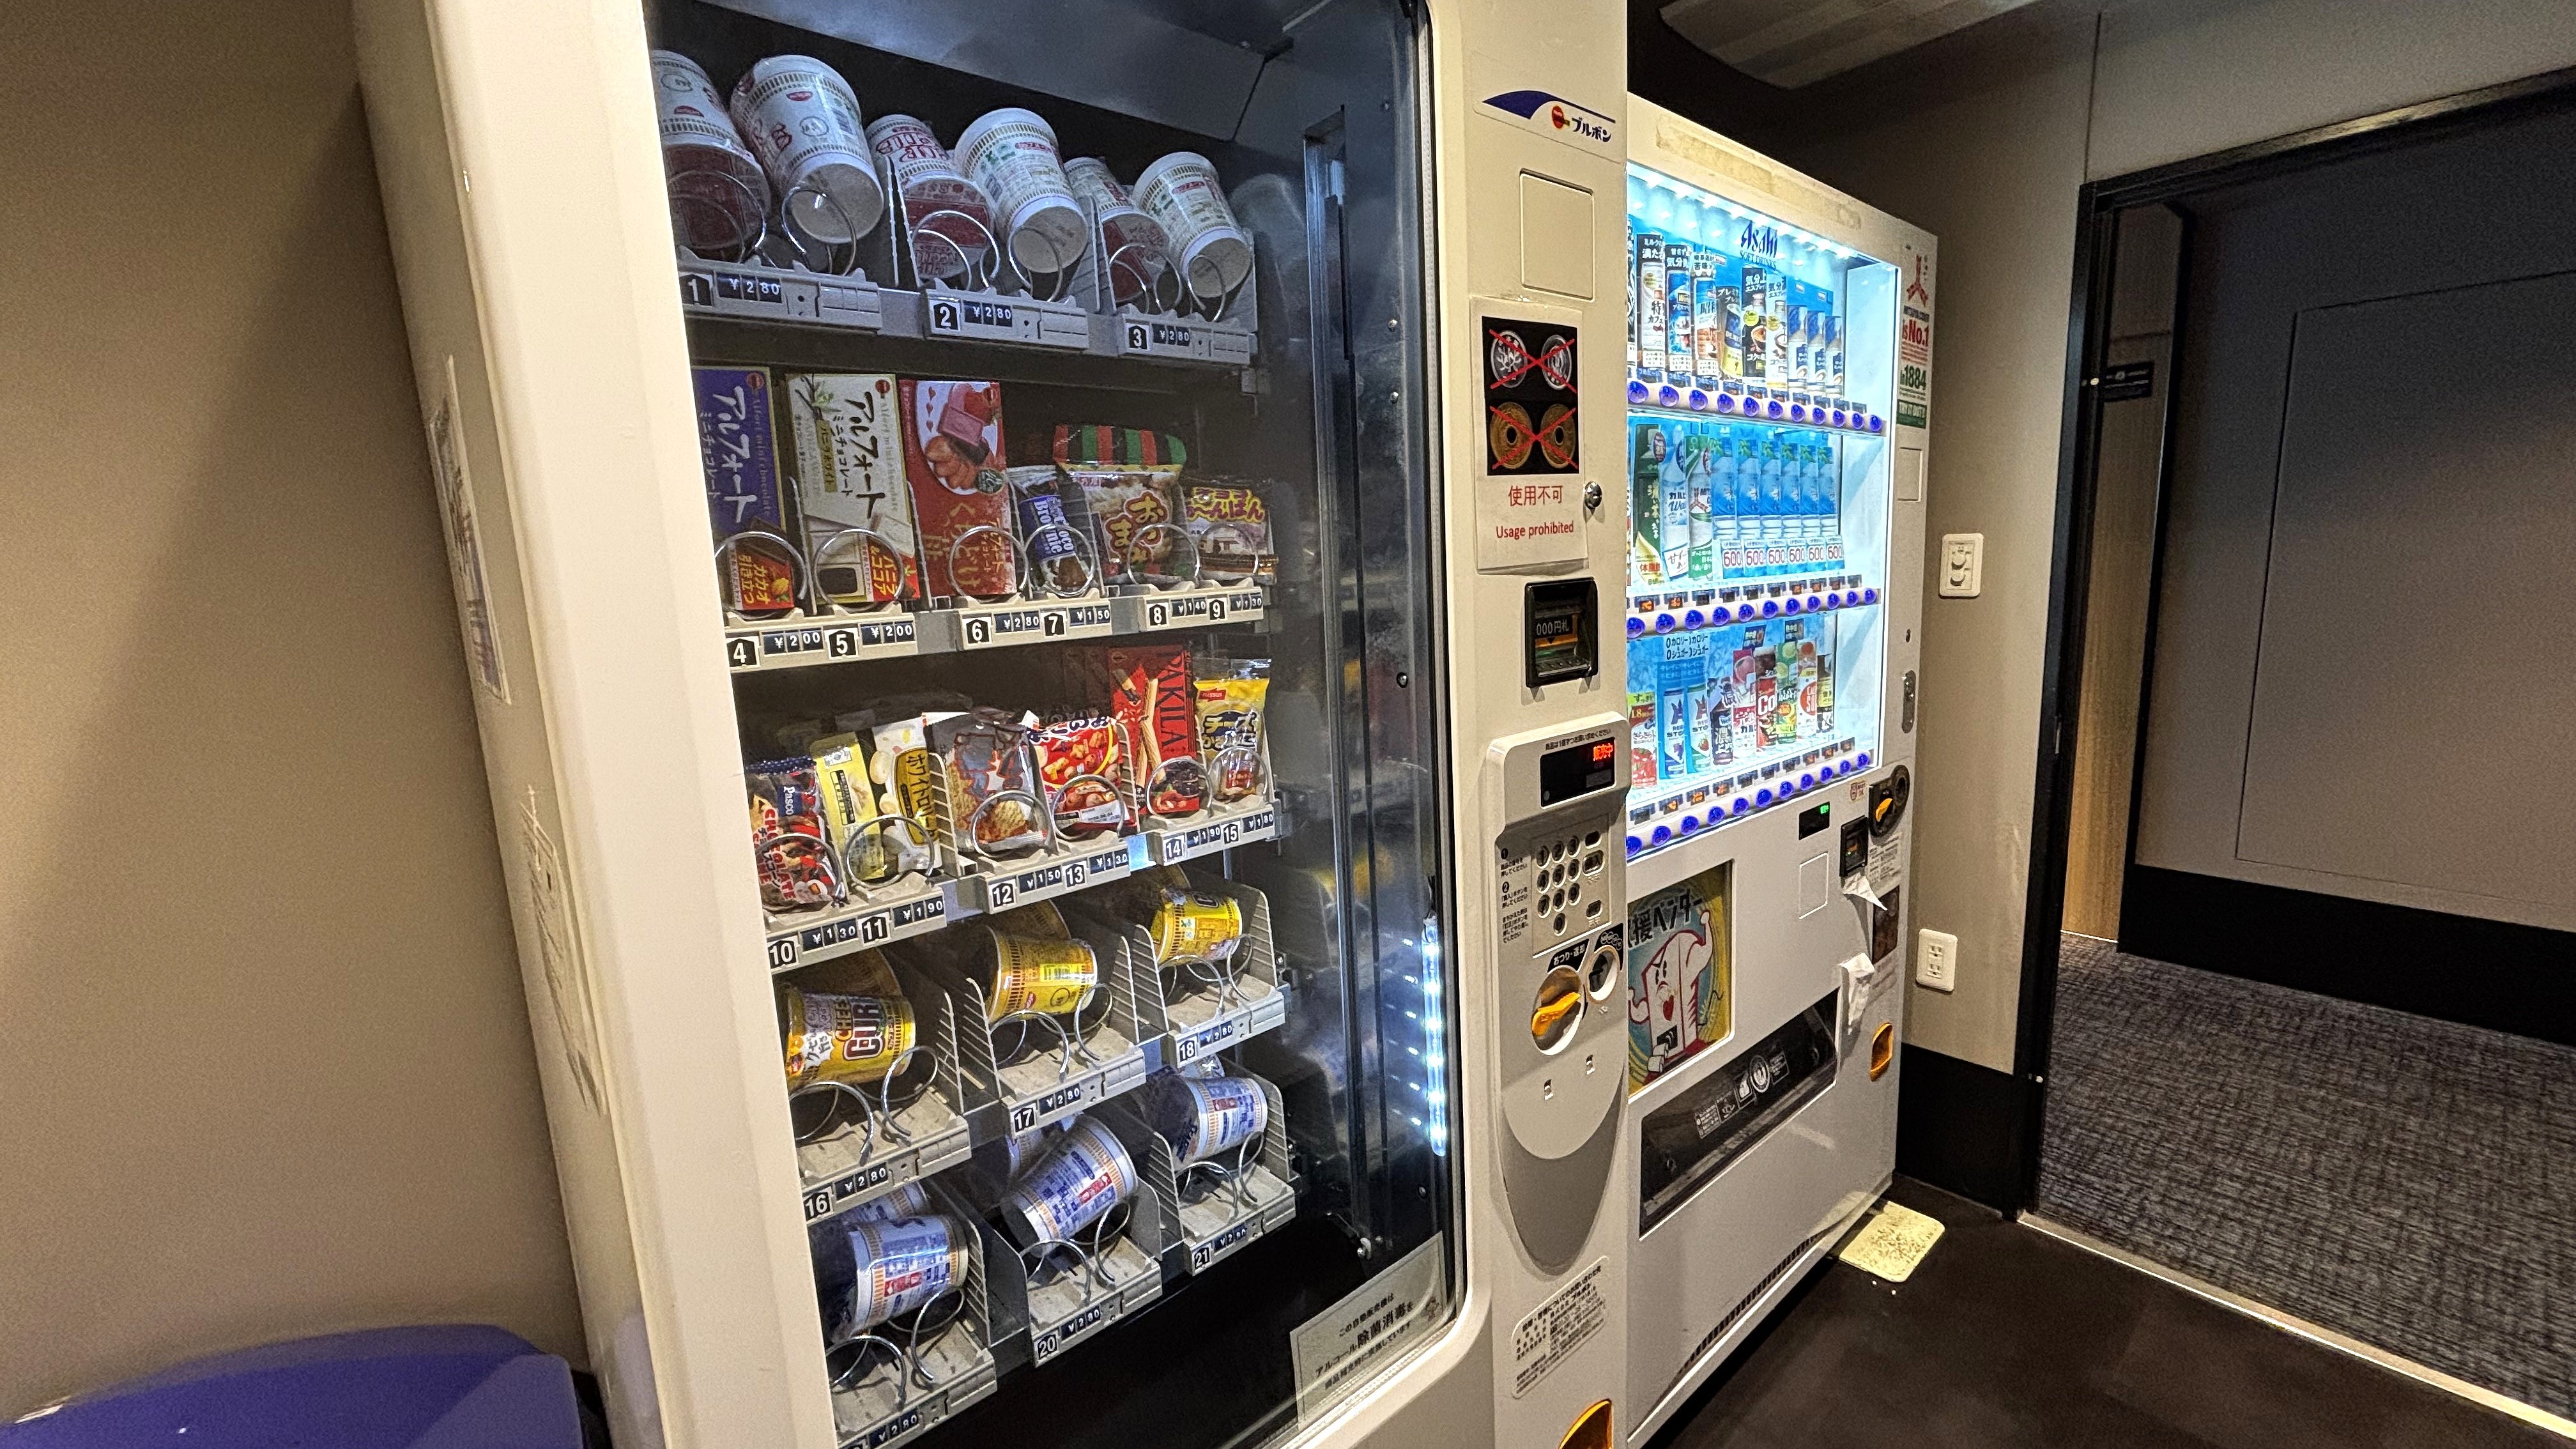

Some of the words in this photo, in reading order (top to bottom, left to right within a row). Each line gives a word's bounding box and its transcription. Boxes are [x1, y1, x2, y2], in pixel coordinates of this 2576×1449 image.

[1572, 117, 1612, 142] ブルボン
[1740, 220, 1778, 259] Asahi
[688, 280, 699, 303] 1
[729, 277, 781, 296] ¥280
[941, 307, 950, 327] 2
[973, 305, 1011, 320] ¥280
[1133, 329, 1142, 347] 3
[1159, 329, 1190, 342] ¥280
[1908, 319, 1929, 346] No.1
[1905, 364, 1926, 390] 1884
[713, 385, 757, 523] アルフォート
[820, 424, 836, 487] バニラホワイト
[832, 415, 853, 498] ミニチョコレート
[845, 390, 886, 519] アルフォート
[1508, 485, 1564, 507] 使用不可
[1496, 524, 1526, 540] Usage
[1528, 520, 1575, 537] prohibited
[1768, 549, 1785, 565] 600
[738, 554, 755, 604] 引き立つ
[752, 564, 772, 604] カカオ
[1177, 601, 1206, 615] ¥140
[1213, 602, 1222, 618] 9
[1236, 597, 1262, 610] ¥130
[1003, 616, 1039, 631] ¥280
[1050, 617, 1058, 634] 7
[1076, 609, 1110, 622] ¥150
[1153, 606, 1163, 625] 8
[774, 631, 820, 648] ¥200
[870, 624, 913, 639] ¥200
[972, 622, 983, 641] 6
[733, 642, 747, 663] 4
[836, 634, 848, 655] 5
[783, 785, 796, 816] Pasco
[908, 753, 939, 840] ホワイトロリータ
[1248, 813, 1273, 829] ¥180
[1193, 828, 1220, 844] ¥190
[1223, 825, 1238, 841] 15
[1166, 839, 1181, 857] 14
[1096, 854, 1128, 868] ¥130
[1026, 870, 1061, 889] ¥150
[1066, 866, 1084, 885] 13
[993, 886, 1013, 905] 12
[903, 901, 943, 921] ¥190
[1628, 888, 1703, 949] 援ベンダー
[813, 925, 856, 945] ¥130
[864, 919, 886, 939] 11
[770, 943, 793, 965] 10
[1552, 944, 1586, 967] おつり・返却
[1205, 1024, 1232, 1042] ¥280
[1179, 1043, 1195, 1060] 18
[1046, 1088, 1080, 1108] ¥280
[1015, 1111, 1033, 1130] 17
[845, 1167, 886, 1192] ¥280
[805, 1195, 829, 1218] 16
[1195, 1250, 1210, 1266] 21
[1068, 1308, 1100, 1333] ¥280
[1038, 1337, 1056, 1355] 20
[878, 1414, 919, 1441] ¥280
